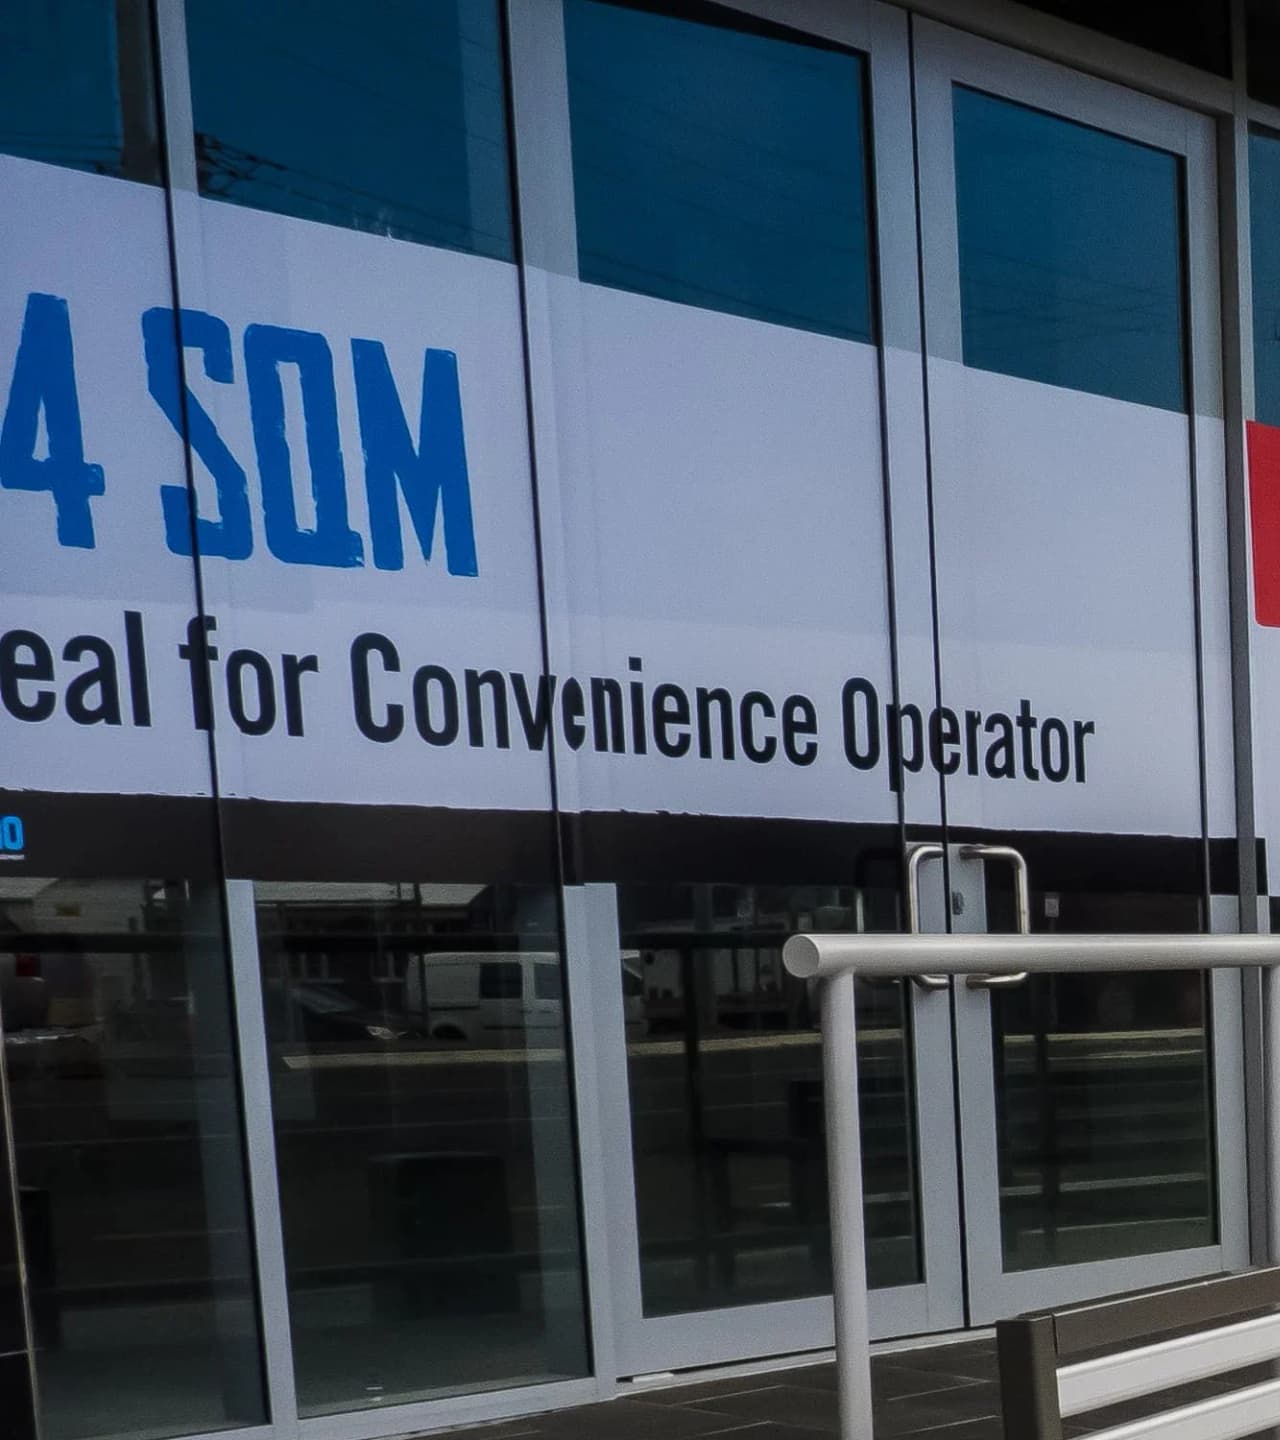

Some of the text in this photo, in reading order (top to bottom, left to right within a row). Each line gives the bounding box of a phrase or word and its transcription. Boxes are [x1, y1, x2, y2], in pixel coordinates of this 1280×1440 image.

[142, 306, 479, 577] SQM
[179, 616, 319, 737] for
[350, 633, 819, 771] Convenience
[842, 676, 1096, 793] Operator
